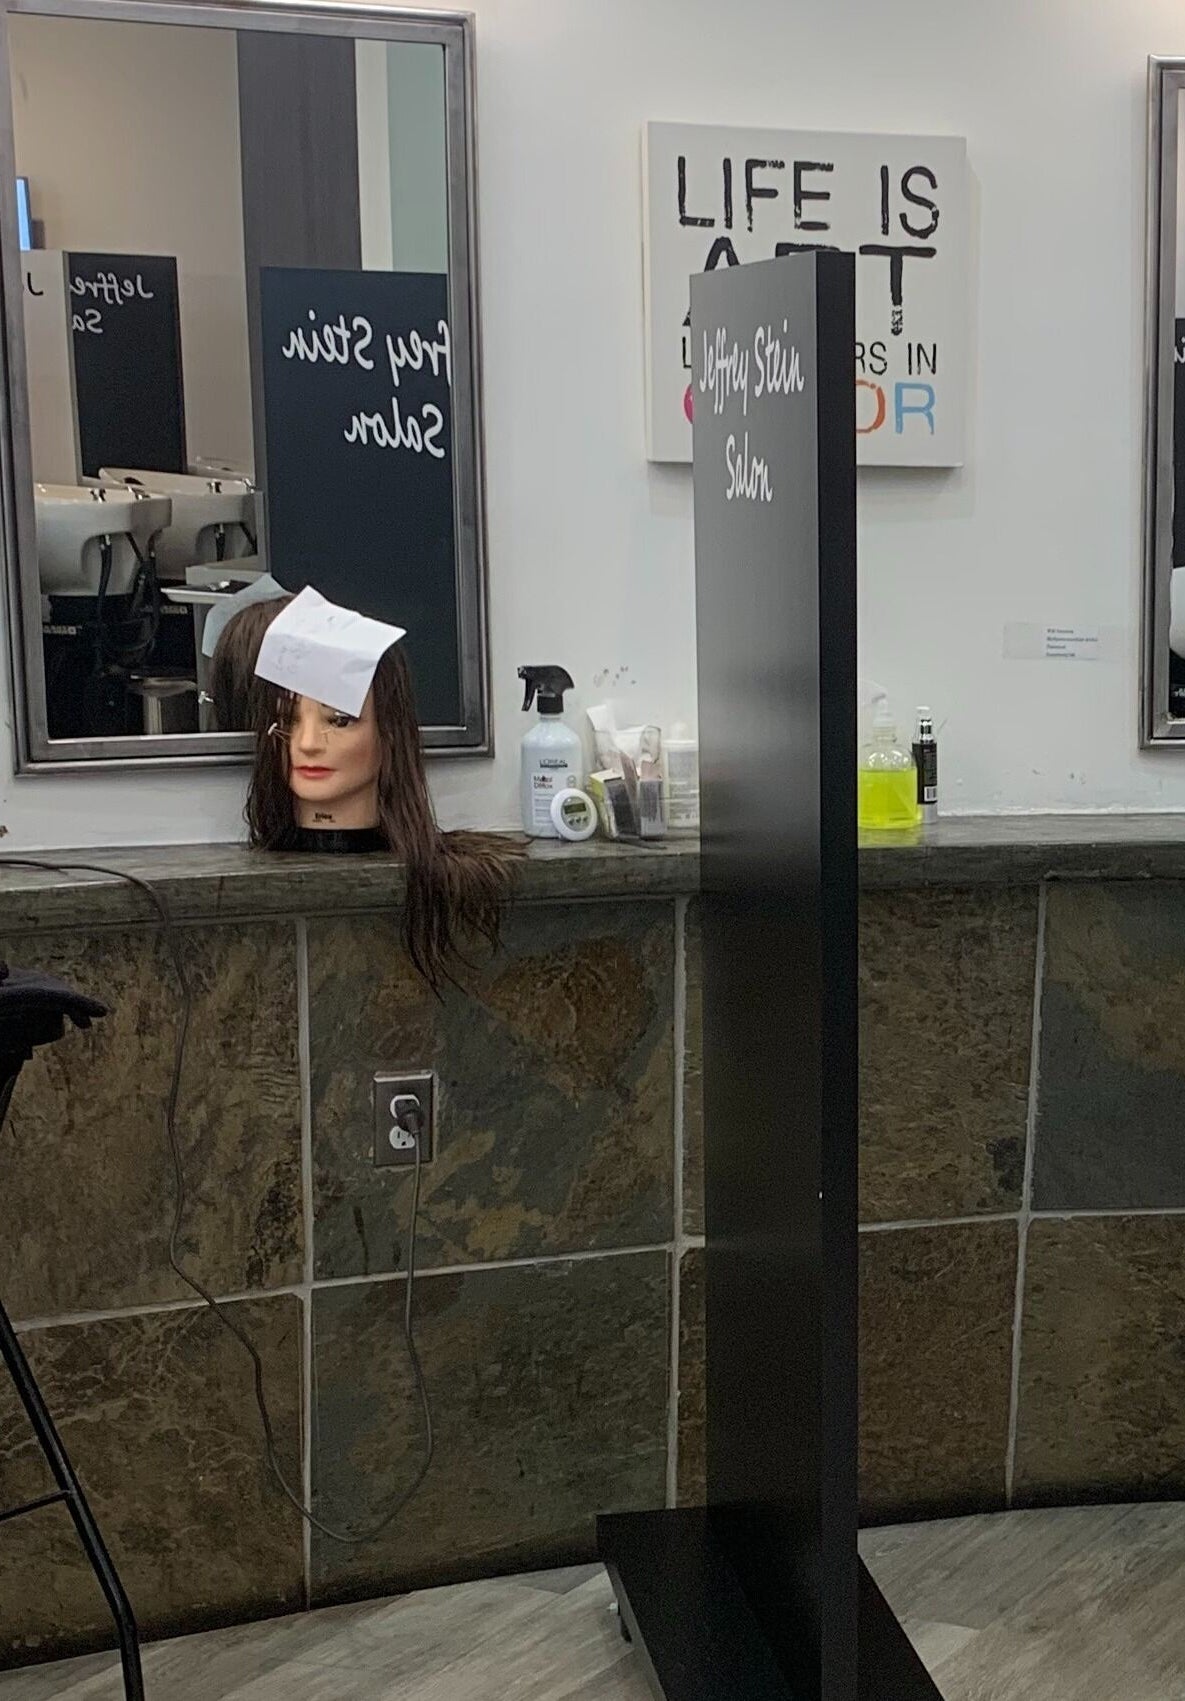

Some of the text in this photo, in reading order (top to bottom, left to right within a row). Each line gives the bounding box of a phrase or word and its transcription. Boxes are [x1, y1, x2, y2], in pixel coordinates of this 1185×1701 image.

[677, 156, 940, 239] LIFE IS
[699, 327, 749, 416] Jeffrey
[754, 318, 804, 398] Stein
[906, 342, 937, 375] IN
[726, 431, 773, 502] Salon
